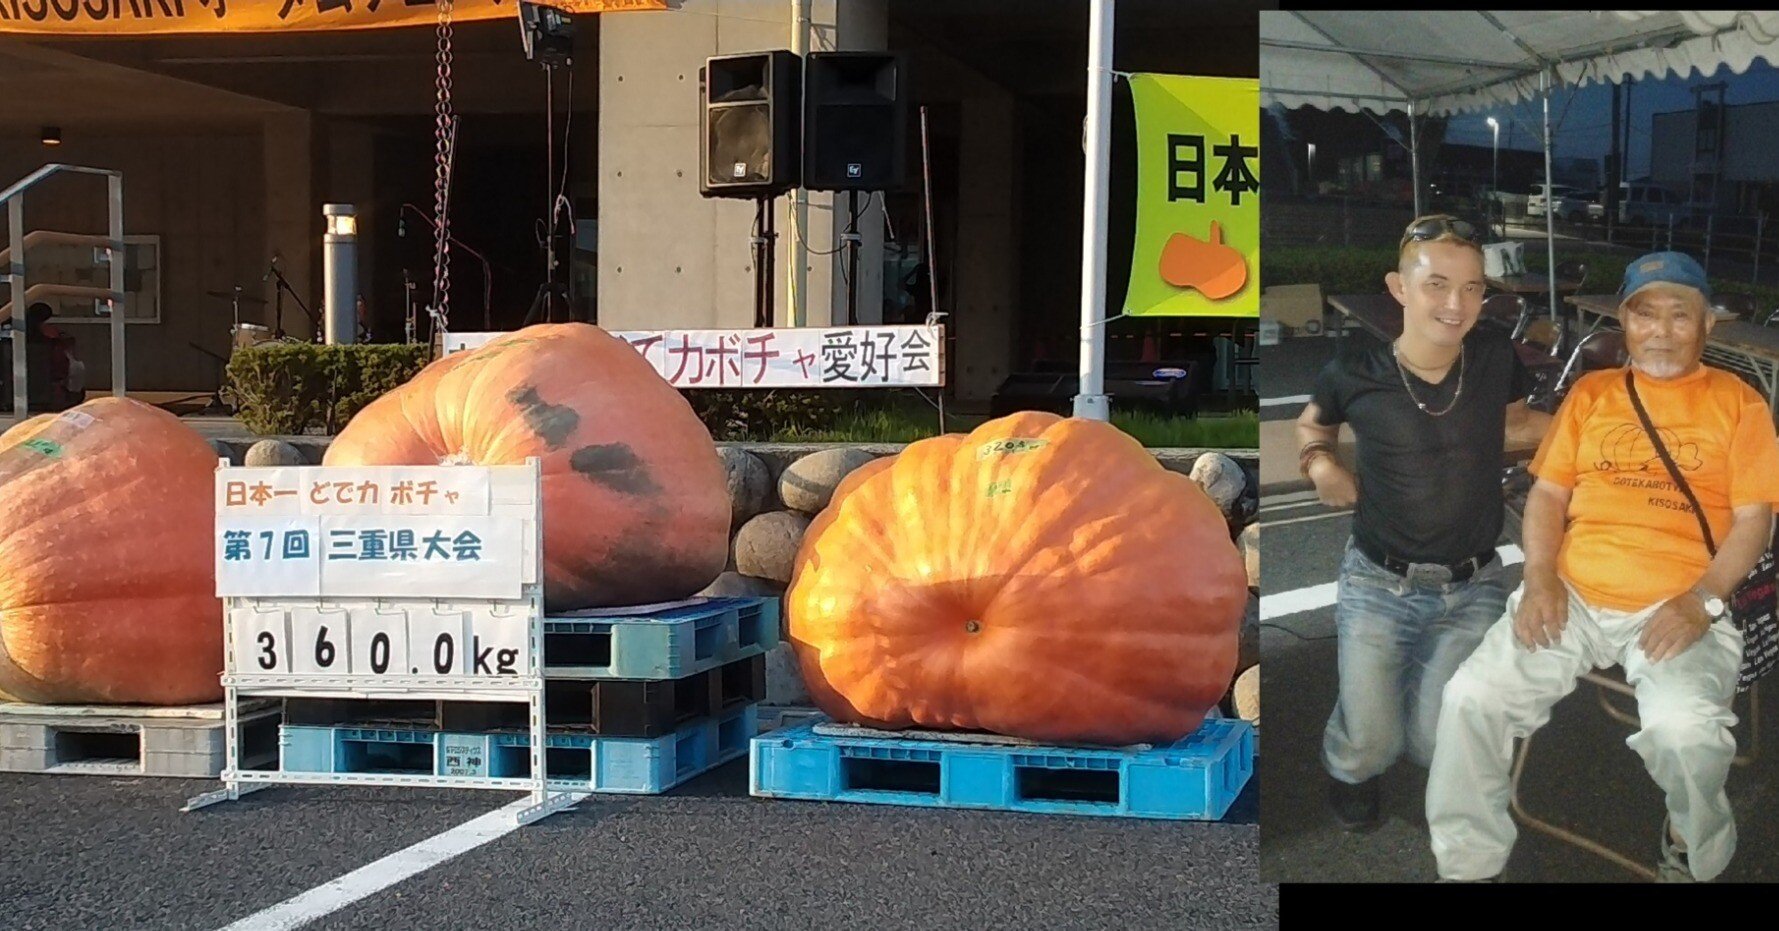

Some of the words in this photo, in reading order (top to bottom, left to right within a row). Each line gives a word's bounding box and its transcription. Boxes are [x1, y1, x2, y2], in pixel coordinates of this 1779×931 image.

[1166, 133, 1259, 206] 日本
[328, 529, 483, 562] 三重県大会
